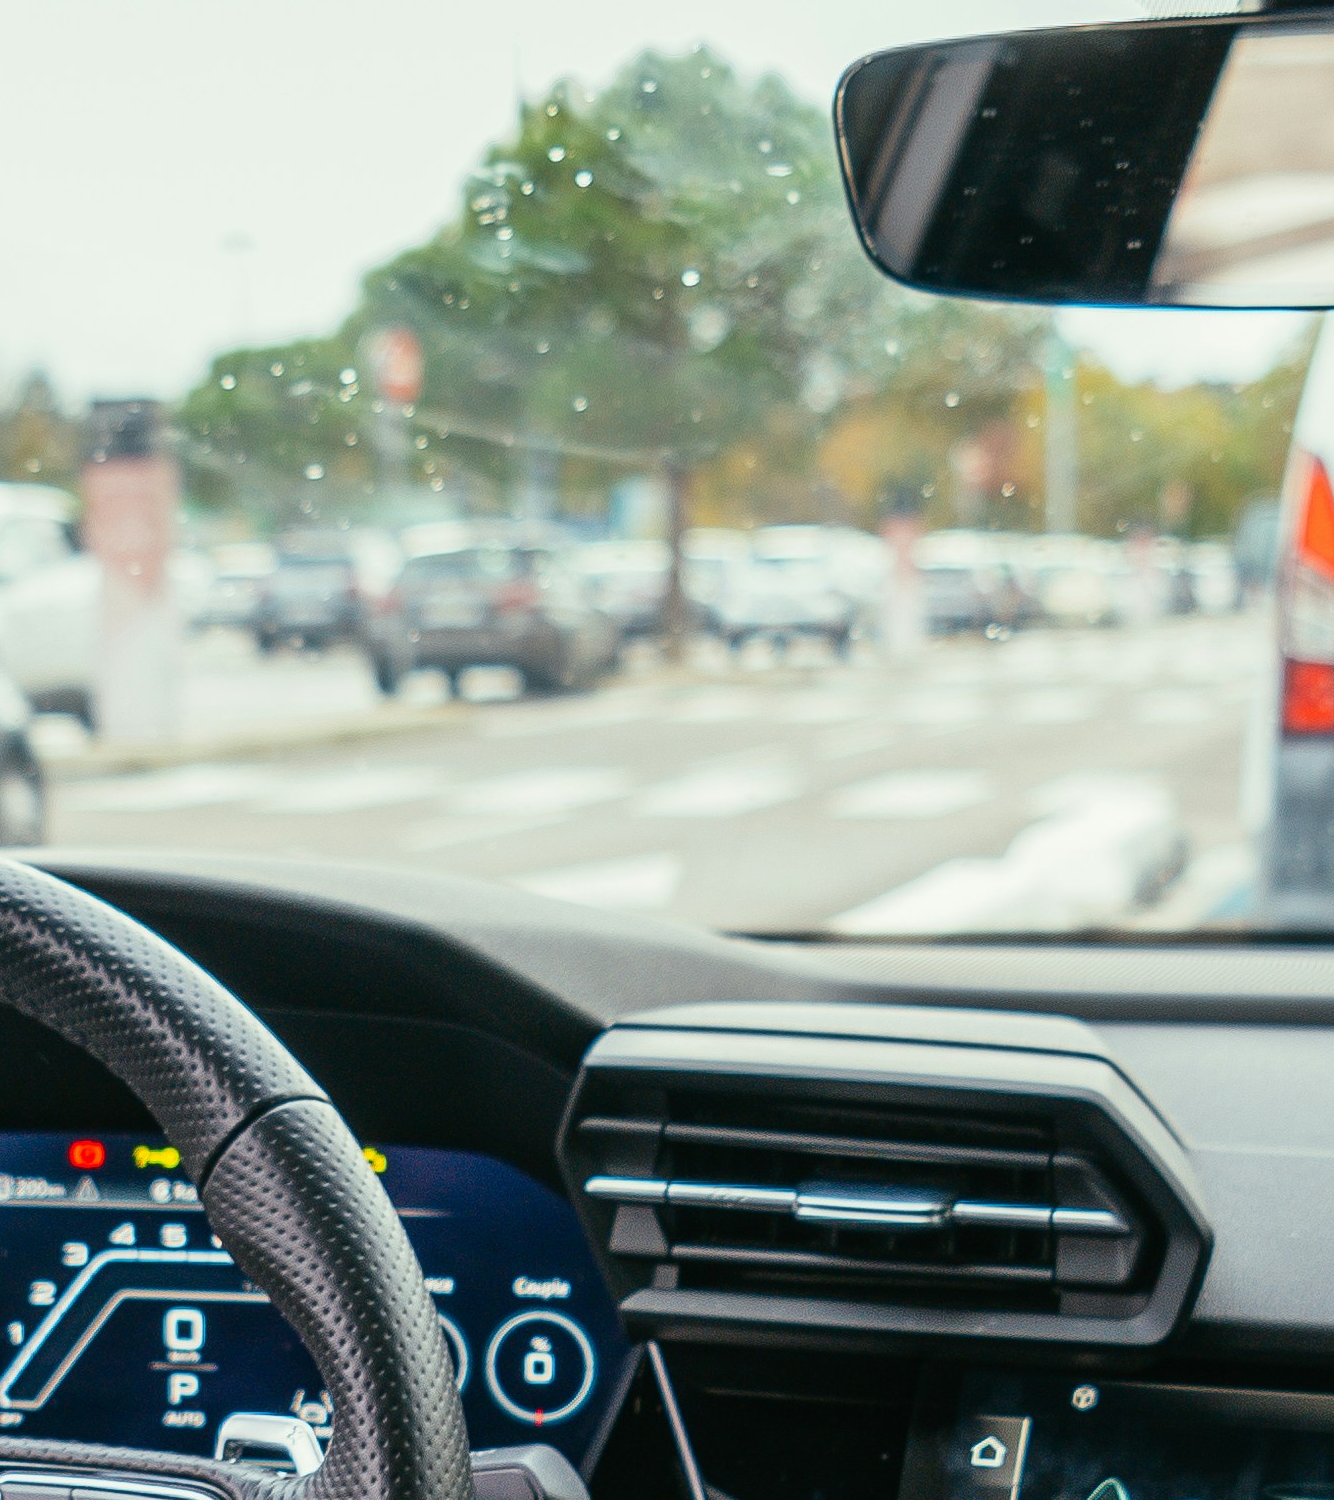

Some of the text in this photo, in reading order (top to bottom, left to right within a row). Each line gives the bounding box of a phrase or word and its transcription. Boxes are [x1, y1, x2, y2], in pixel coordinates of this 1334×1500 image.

[109, 1222, 135, 1246] 4
[61, 1242, 88, 1267] 3
[28, 1279, 57, 1305] 2
[7, 1320, 24, 1345] 1
[163, 1308, 205, 1350] 0
[524, 1352, 555, 1384] 0
[168, 1372, 200, 1405] P
